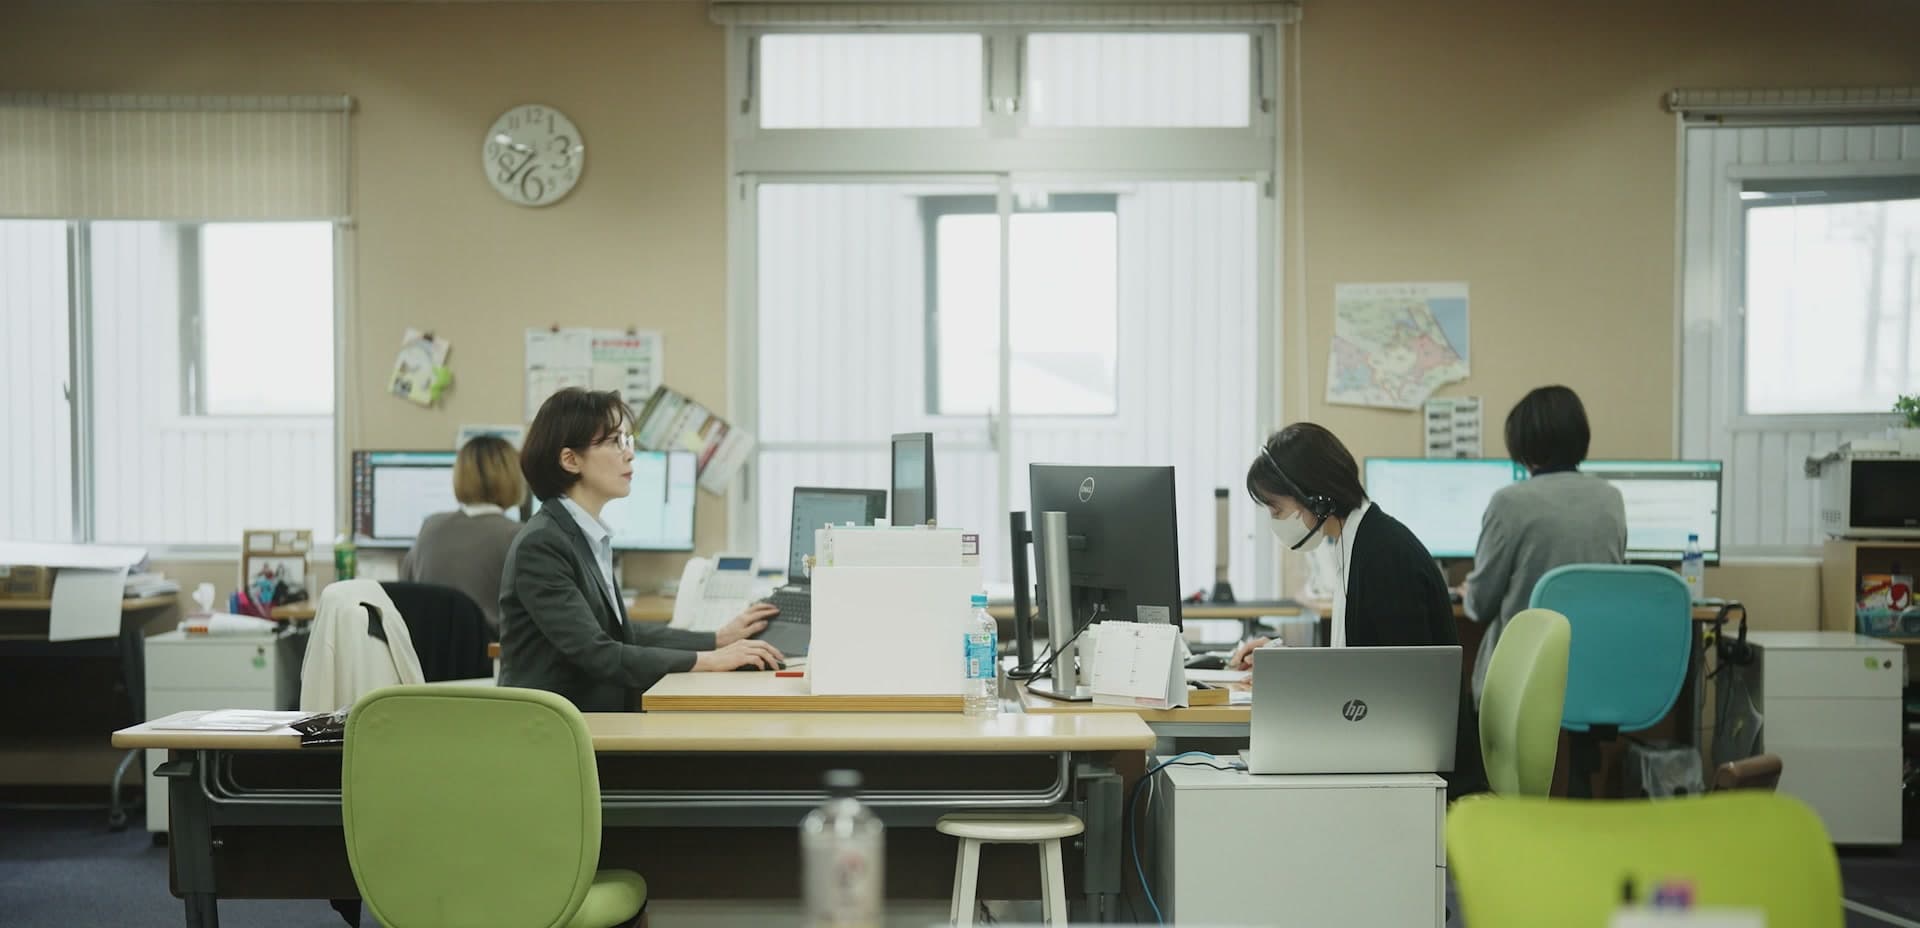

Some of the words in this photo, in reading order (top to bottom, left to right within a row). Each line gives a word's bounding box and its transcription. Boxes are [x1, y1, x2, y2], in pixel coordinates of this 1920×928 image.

[526, 108, 543, 124] 12
[548, 113, 554, 134] 1
[550, 134, 571, 169] 3
[521, 164, 544, 201] 6
[1345, 699, 1365, 721] hp
